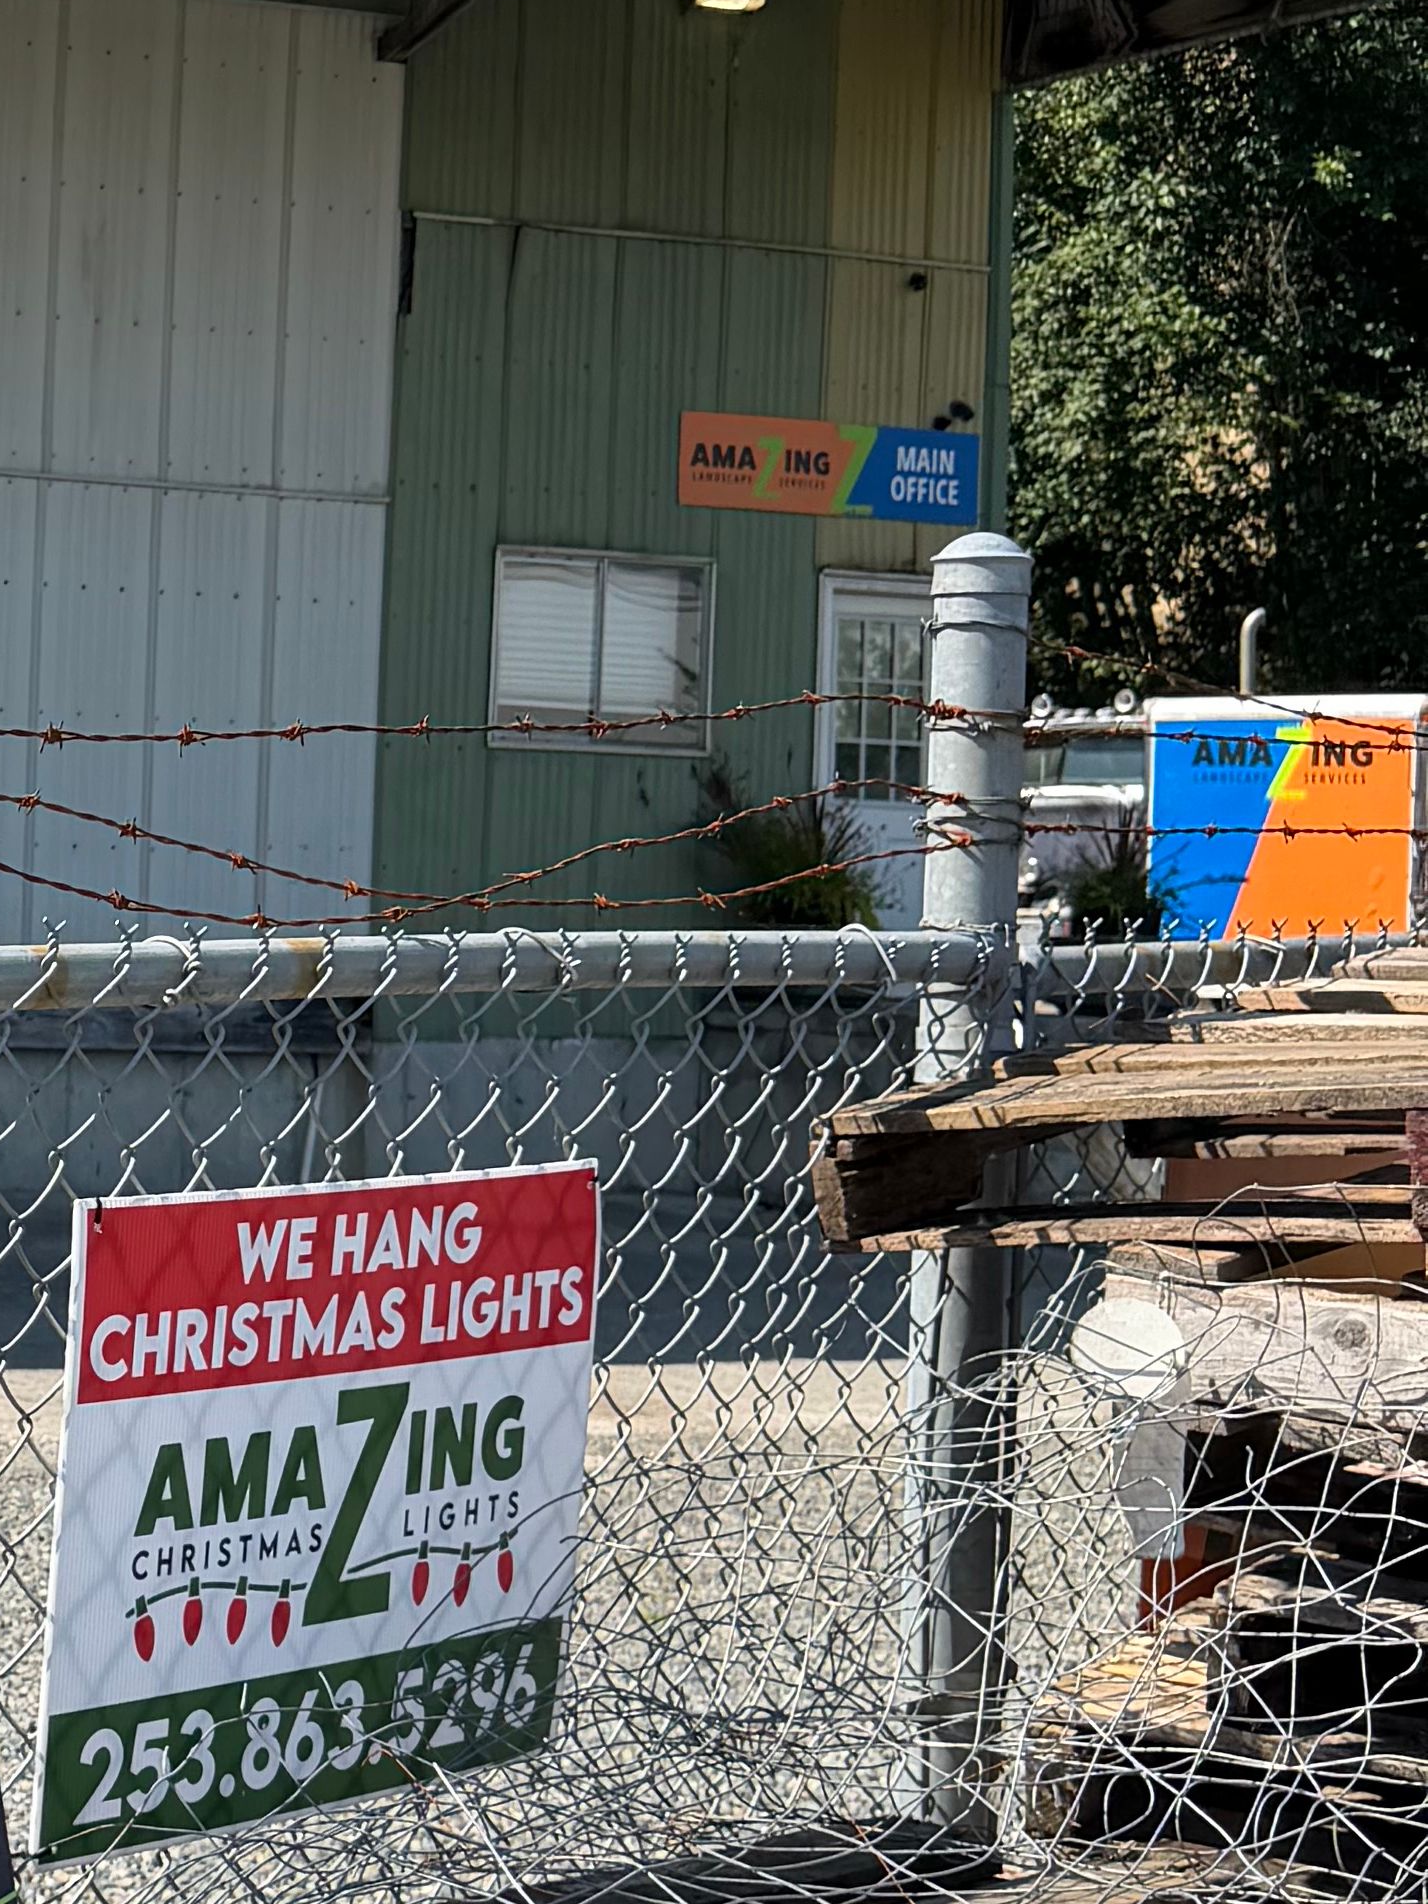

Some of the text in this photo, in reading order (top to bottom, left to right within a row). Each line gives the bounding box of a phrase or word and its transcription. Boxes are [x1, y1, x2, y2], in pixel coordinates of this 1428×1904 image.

[890, 477, 959, 506] OFFICE
[896, 446, 955, 475] MAIN
[237, 1202, 483, 1285] WE HANG
[89, 1266, 584, 1382] CHRISTMAS LIGHTS
[131, 1490, 521, 1580] CHRISTMAS LIGHTS
[133, 1381, 526, 1627] AMAZING
